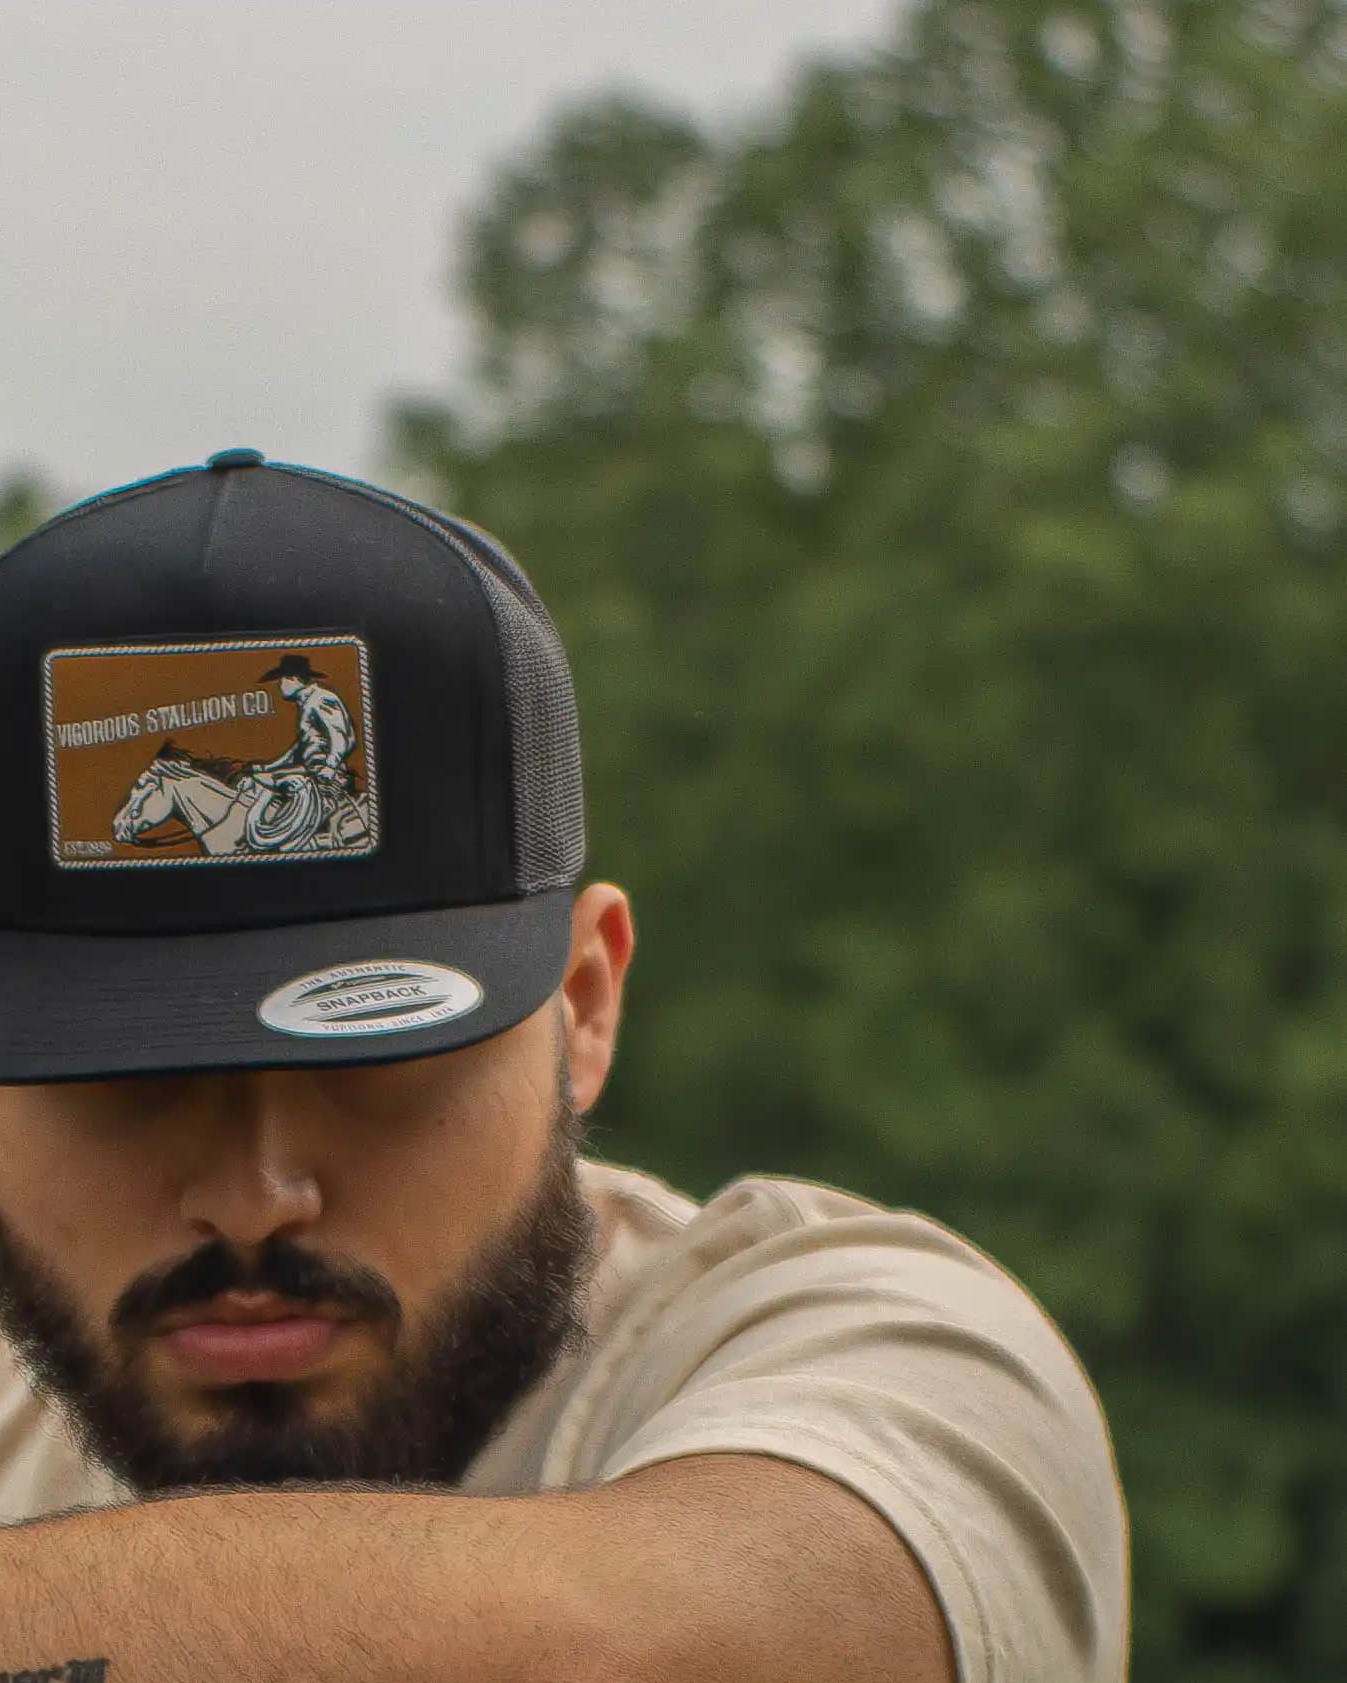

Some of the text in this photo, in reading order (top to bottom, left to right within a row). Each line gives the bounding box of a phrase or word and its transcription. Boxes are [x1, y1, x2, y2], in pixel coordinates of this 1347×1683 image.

[56, 712, 141, 748] VIGOROUS
[146, 694, 236, 733] STALLION
[330, 965, 407, 980] AUTHENTIC
[316, 985, 427, 1011] SNAPBACK
